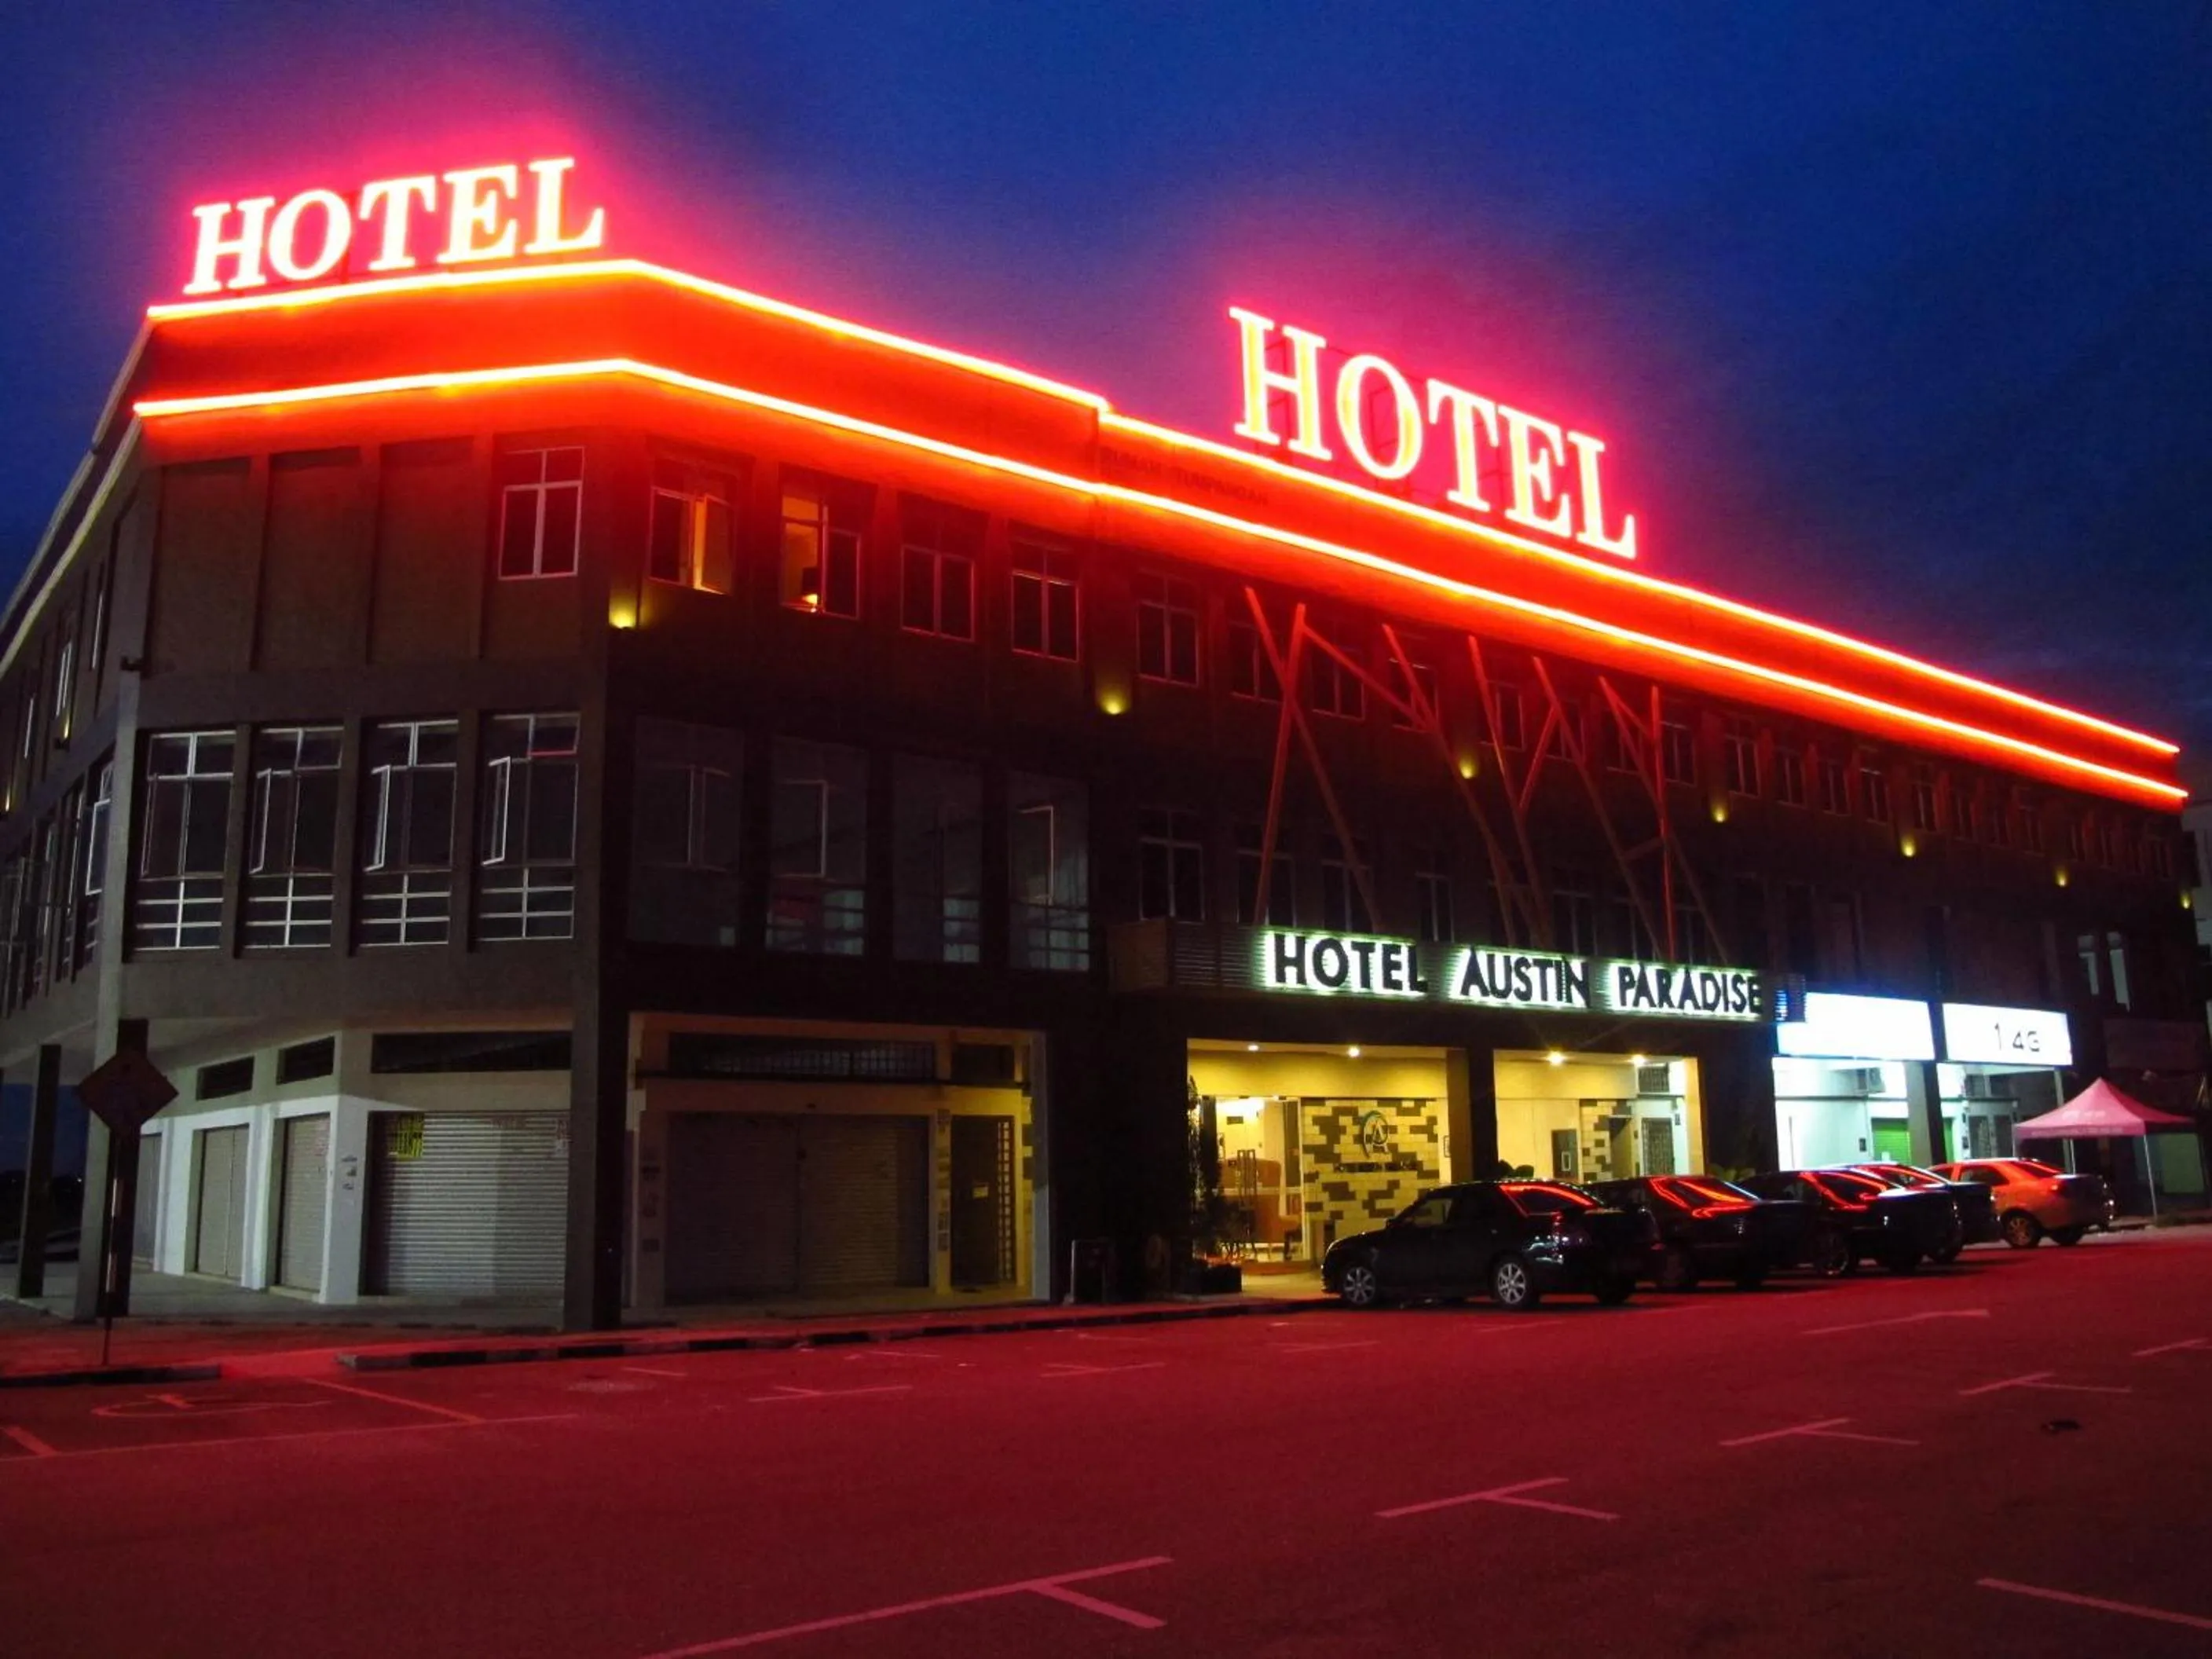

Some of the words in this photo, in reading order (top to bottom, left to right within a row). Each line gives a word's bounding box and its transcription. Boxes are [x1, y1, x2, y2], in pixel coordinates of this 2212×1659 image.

[182, 156, 605, 295] HOTEL
[1229, 306, 1636, 559] HOTEL
[1273, 931, 1429, 994] HOTEL
[1459, 943, 1590, 1009] AUSTIN
[1618, 963, 1763, 1014] PARADISE
